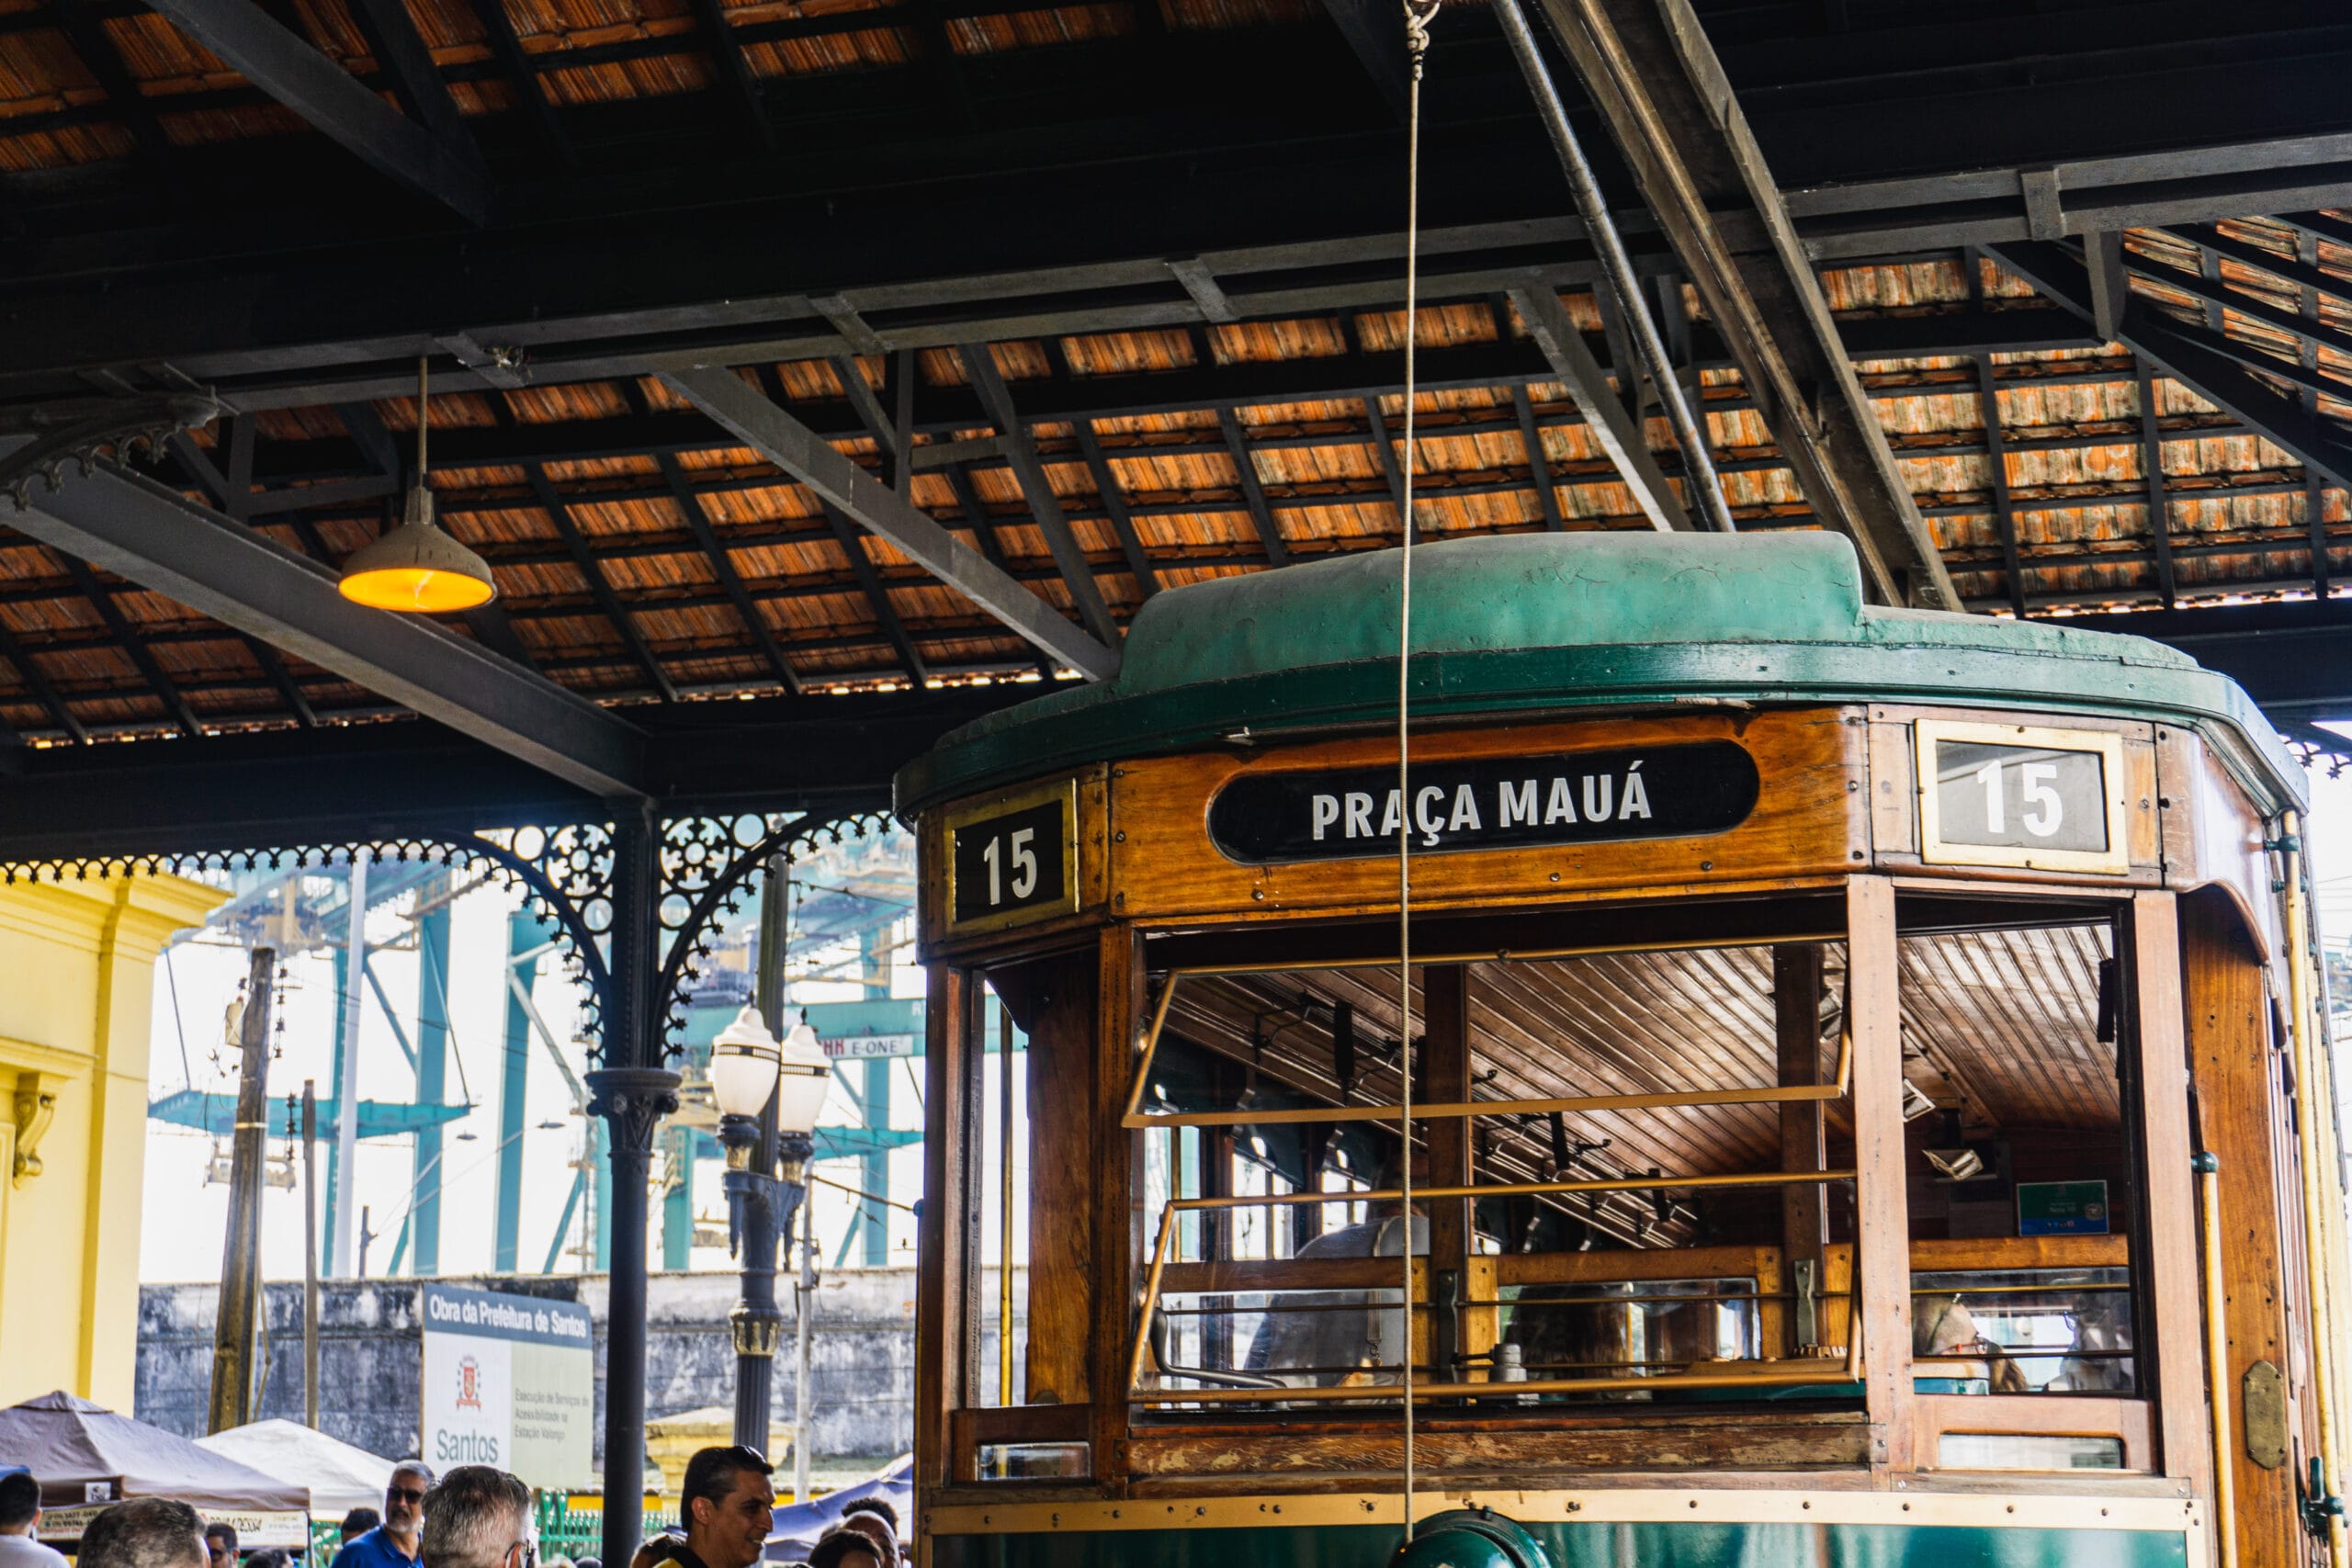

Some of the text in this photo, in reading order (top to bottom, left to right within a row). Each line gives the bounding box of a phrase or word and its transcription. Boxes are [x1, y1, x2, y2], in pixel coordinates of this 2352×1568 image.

[1312, 760, 1653, 847] PRAÇA MAUÁ
[1976, 759, 2064, 838] 15
[983, 827, 1038, 906] 15
[429, 1293, 587, 1338] Obra da Prefeitura de Santos
[435, 1427, 499, 1463] Santos
